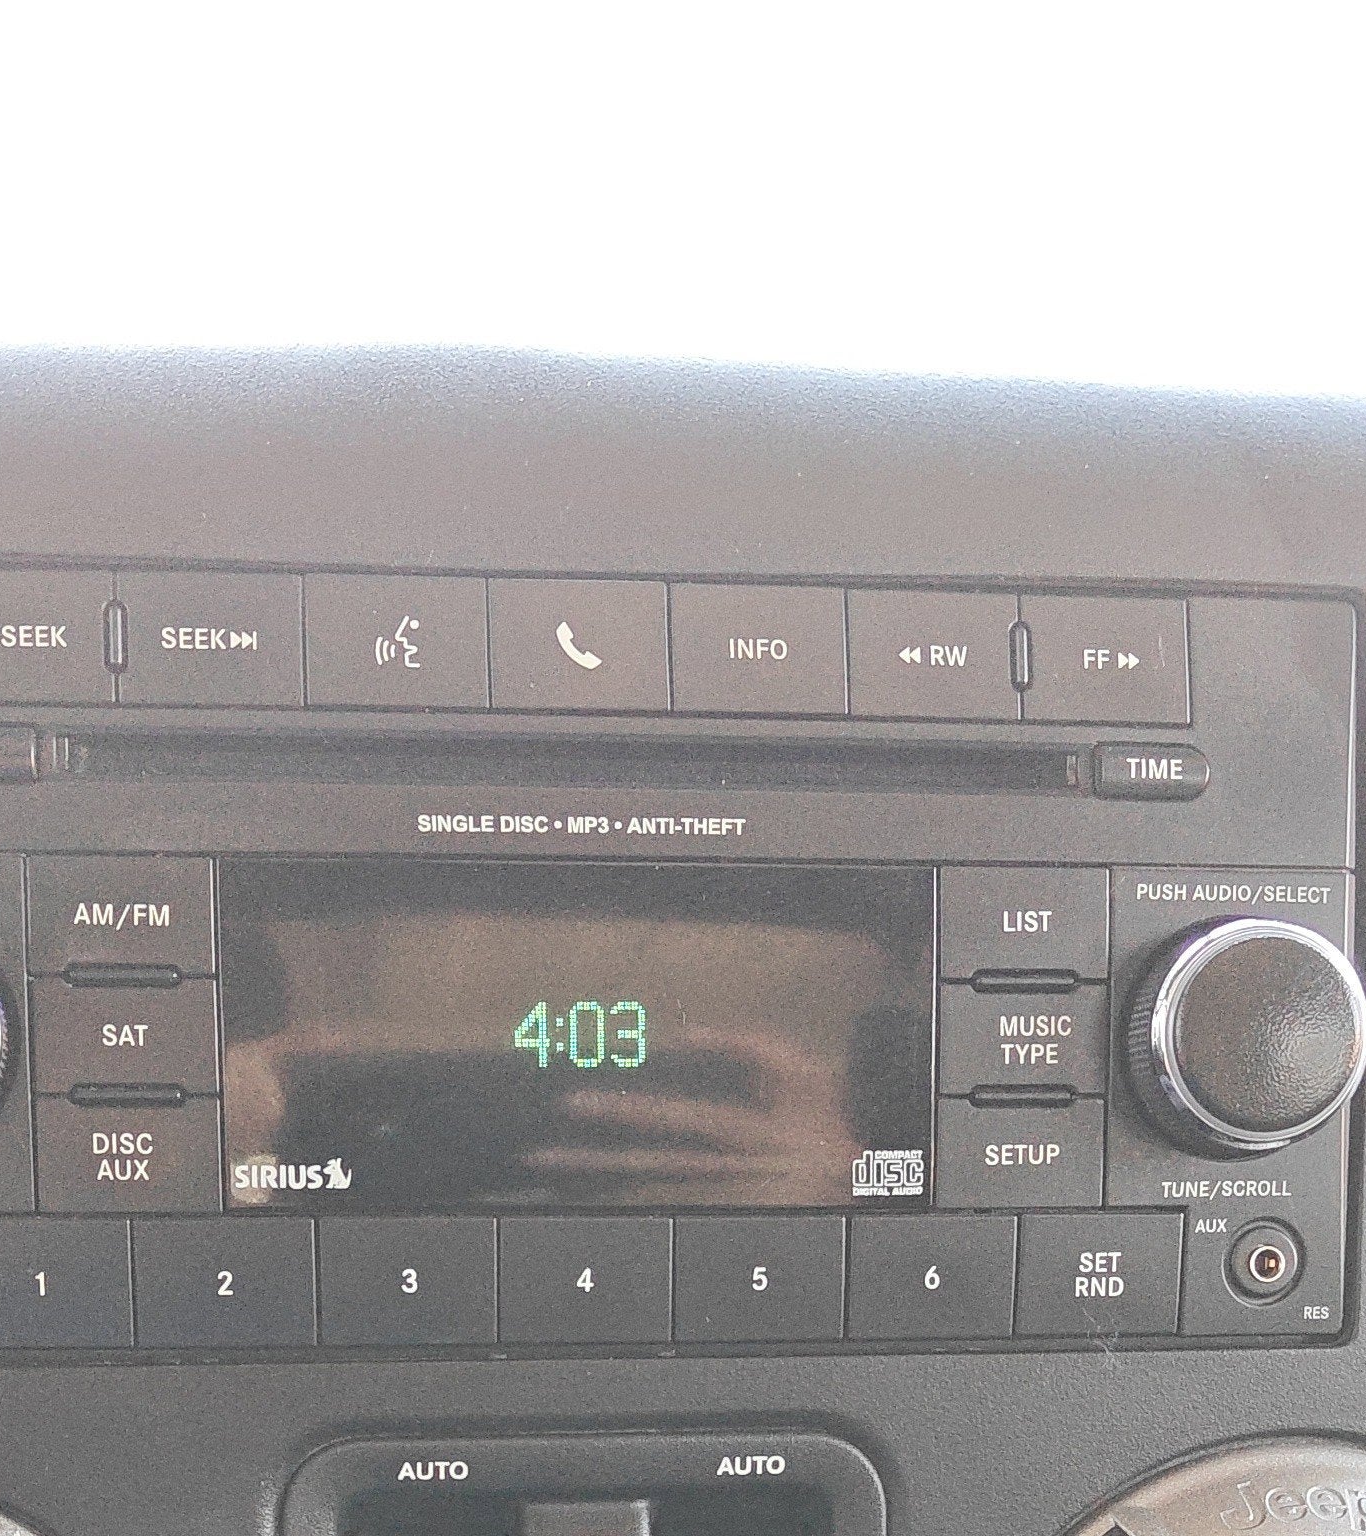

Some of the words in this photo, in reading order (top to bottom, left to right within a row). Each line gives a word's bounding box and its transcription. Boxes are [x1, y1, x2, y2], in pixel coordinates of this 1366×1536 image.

[0, 624, 67, 648] SEEK
[161, 626, 227, 650] SEEK
[729, 638, 788, 660] INFO
[930, 645, 968, 667] RW
[1083, 648, 1110, 670] FF
[1126, 757, 1183, 780] TIME
[417, 814, 495, 833] SINGLE
[500, 815, 549, 833] DISC
[567, 816, 610, 834] MP3
[626, 817, 747, 836] ANTI-THEFT
[1136, 883, 1187, 901] PUSH
[1192, 884, 1331, 905] AUDIO/SELECT
[73, 902, 170, 931] AM/FM
[1003, 910, 1053, 933] LIST
[102, 1023, 149, 1047] SAT
[514, 1001, 646, 1068] 4:03
[999, 1015, 1072, 1037] MUSIC
[1000, 1043, 1059, 1065] TYPE
[92, 1132, 153, 1155] DISC
[875, 1149, 923, 1159] COMPACT
[984, 1143, 1060, 1166] SETUP
[97, 1158, 150, 1181] AUX
[234, 1164, 324, 1190] SIRIUS
[852, 1187, 890, 1196] DIGITAL
[892, 1186, 923, 1195] AUDIO
[1161, 1180, 1292, 1201] TUNE/SCROLL
[1194, 1218, 1228, 1233] AUX
[1079, 1251, 1122, 1273] SET
[34, 1271, 47, 1297] 1
[217, 1270, 234, 1296] 2
[401, 1268, 418, 1294] 3
[576, 1267, 595, 1293] 4
[752, 1266, 768, 1291] 5
[924, 1265, 941, 1290] 6
[1075, 1276, 1124, 1298] RND
[1302, 1305, 1331, 1321] RES
[397, 1460, 469, 1481] AUTO
[716, 1455, 786, 1476] AUTO
